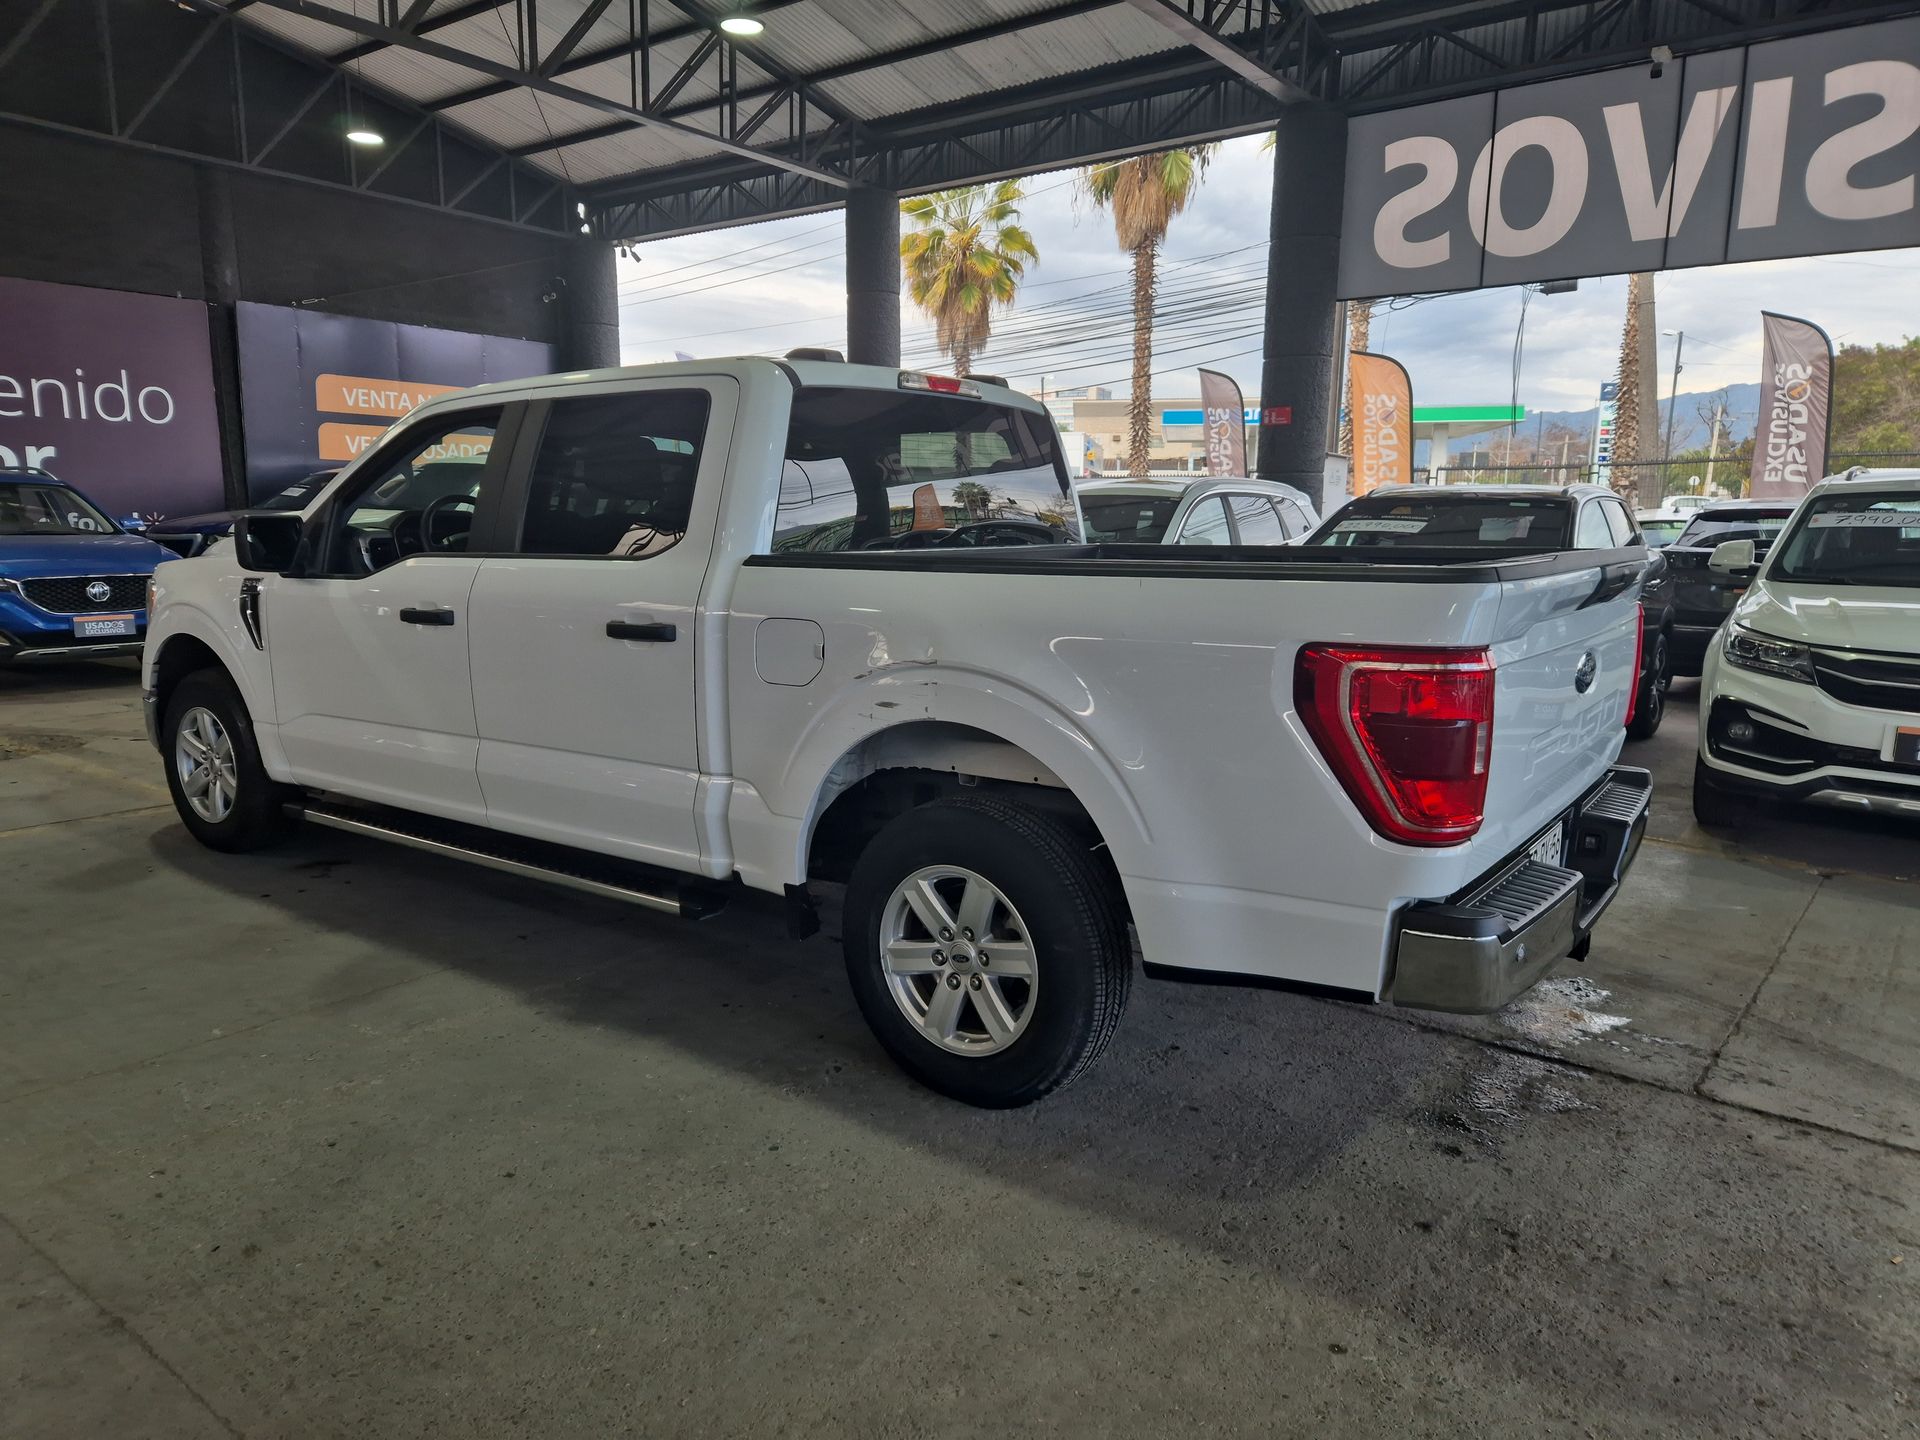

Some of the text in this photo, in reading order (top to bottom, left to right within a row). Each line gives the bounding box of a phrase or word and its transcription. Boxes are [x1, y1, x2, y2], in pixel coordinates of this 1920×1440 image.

[342, 387, 412, 411] VENTA
[345, 435, 378, 454] VE
[84, 620, 125, 630] USADOS
[85, 627, 125, 636] EXCLUSIVOS
